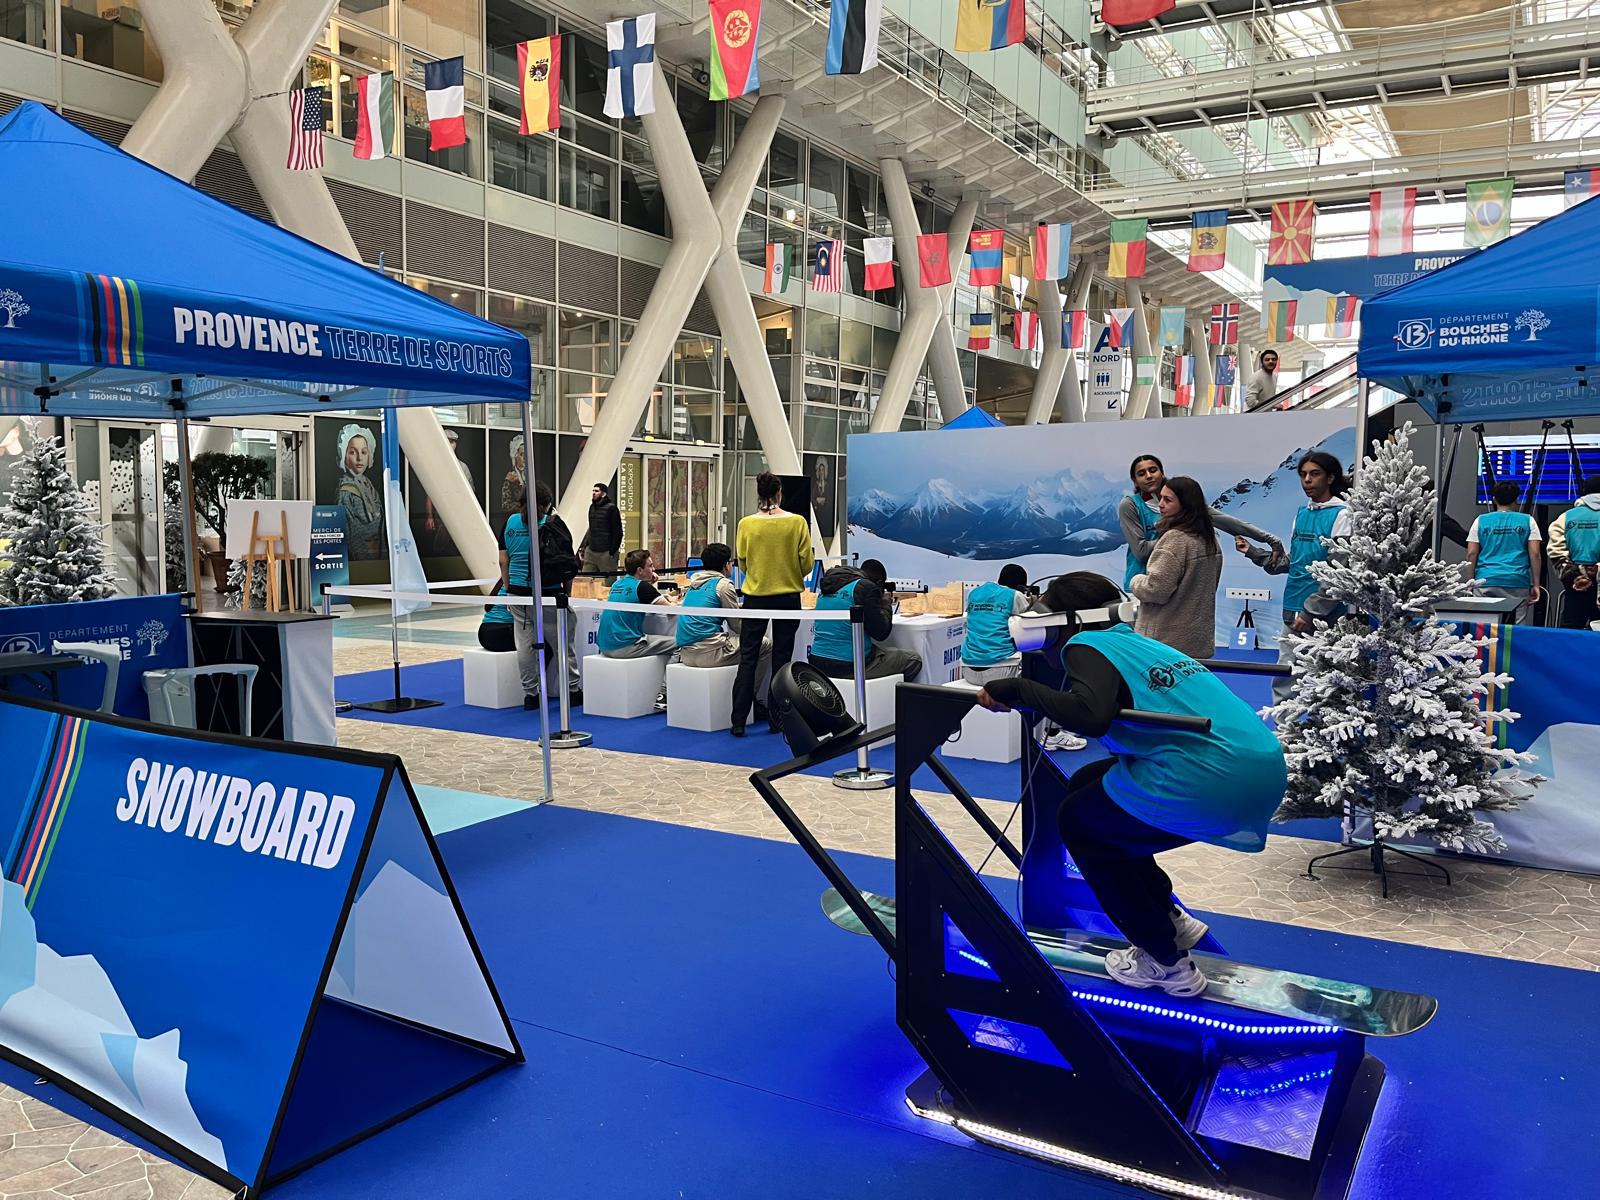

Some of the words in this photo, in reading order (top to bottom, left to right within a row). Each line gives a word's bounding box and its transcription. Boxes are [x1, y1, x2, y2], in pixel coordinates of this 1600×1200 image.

[1414, 256, 1466, 271] PROVE
[173, 307, 323, 357] PROVENCE
[325, 326, 403, 366] TERRE
[404, 336, 433, 369] DE
[435, 341, 513, 378] SPORTS
[1092, 354, 1121, 363] NORD
[621, 463, 626, 473] LA
[621, 501, 626, 511] DE
[1237, 631, 1248, 646] 5
[116, 757, 356, 870] SNOWBOARD
